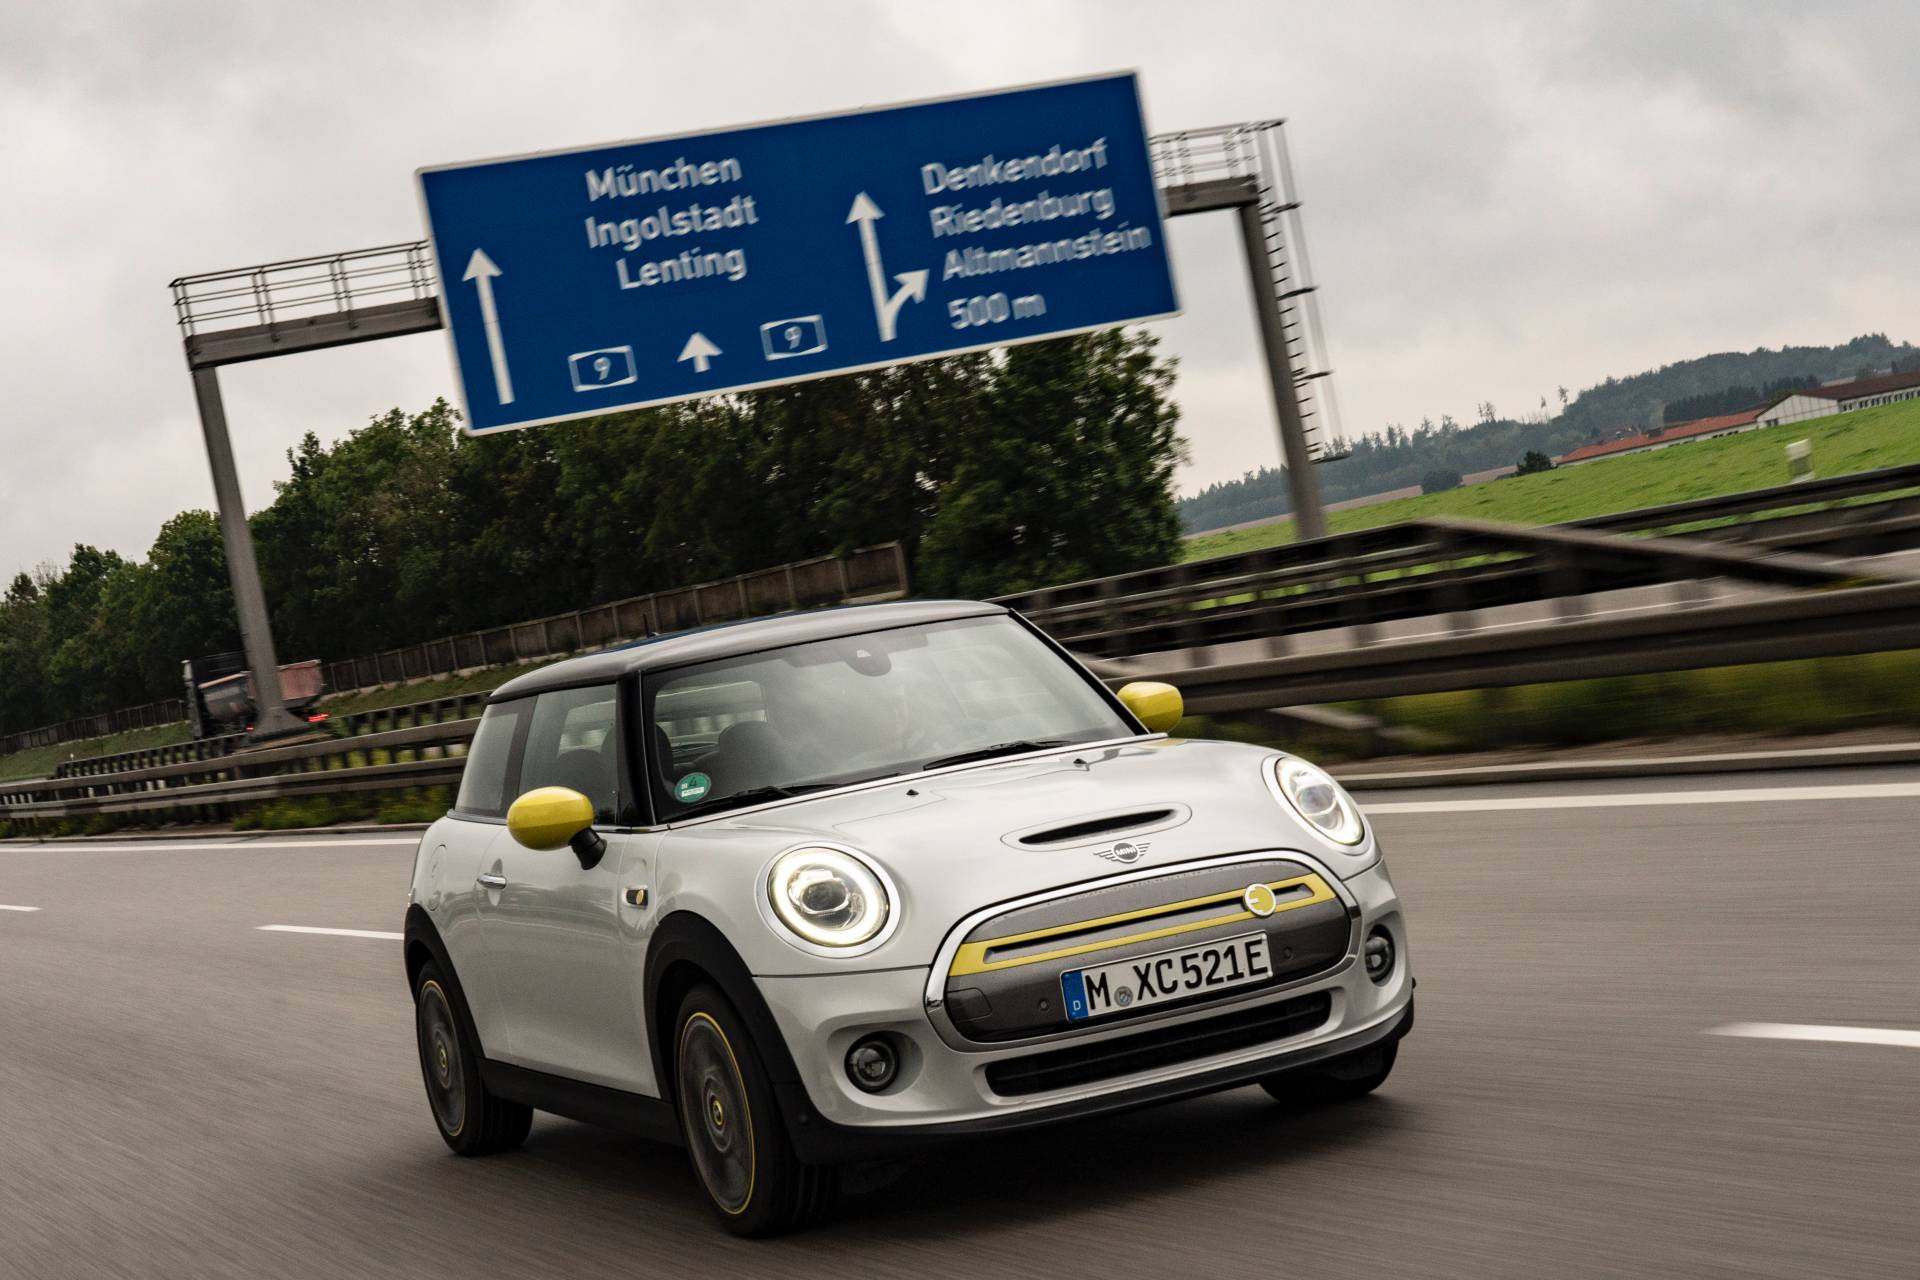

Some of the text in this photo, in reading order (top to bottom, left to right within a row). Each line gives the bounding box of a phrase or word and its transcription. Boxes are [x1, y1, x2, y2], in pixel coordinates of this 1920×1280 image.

[585, 156, 742, 202] München
[921, 137, 1107, 194] Denkendorf
[585, 195, 759, 251] Ingolstadt
[930, 188, 1115, 238] Riedenburg
[616, 247, 747, 289] Lenting
[943, 223, 1152, 281] Altmannstein
[948, 293, 1047, 329] 500 m
[784, 326, 803, 349] 9
[593, 356, 612, 381] 9
[1073, 1000, 1082, 1011] D
[1084, 972, 1111, 1010] M
